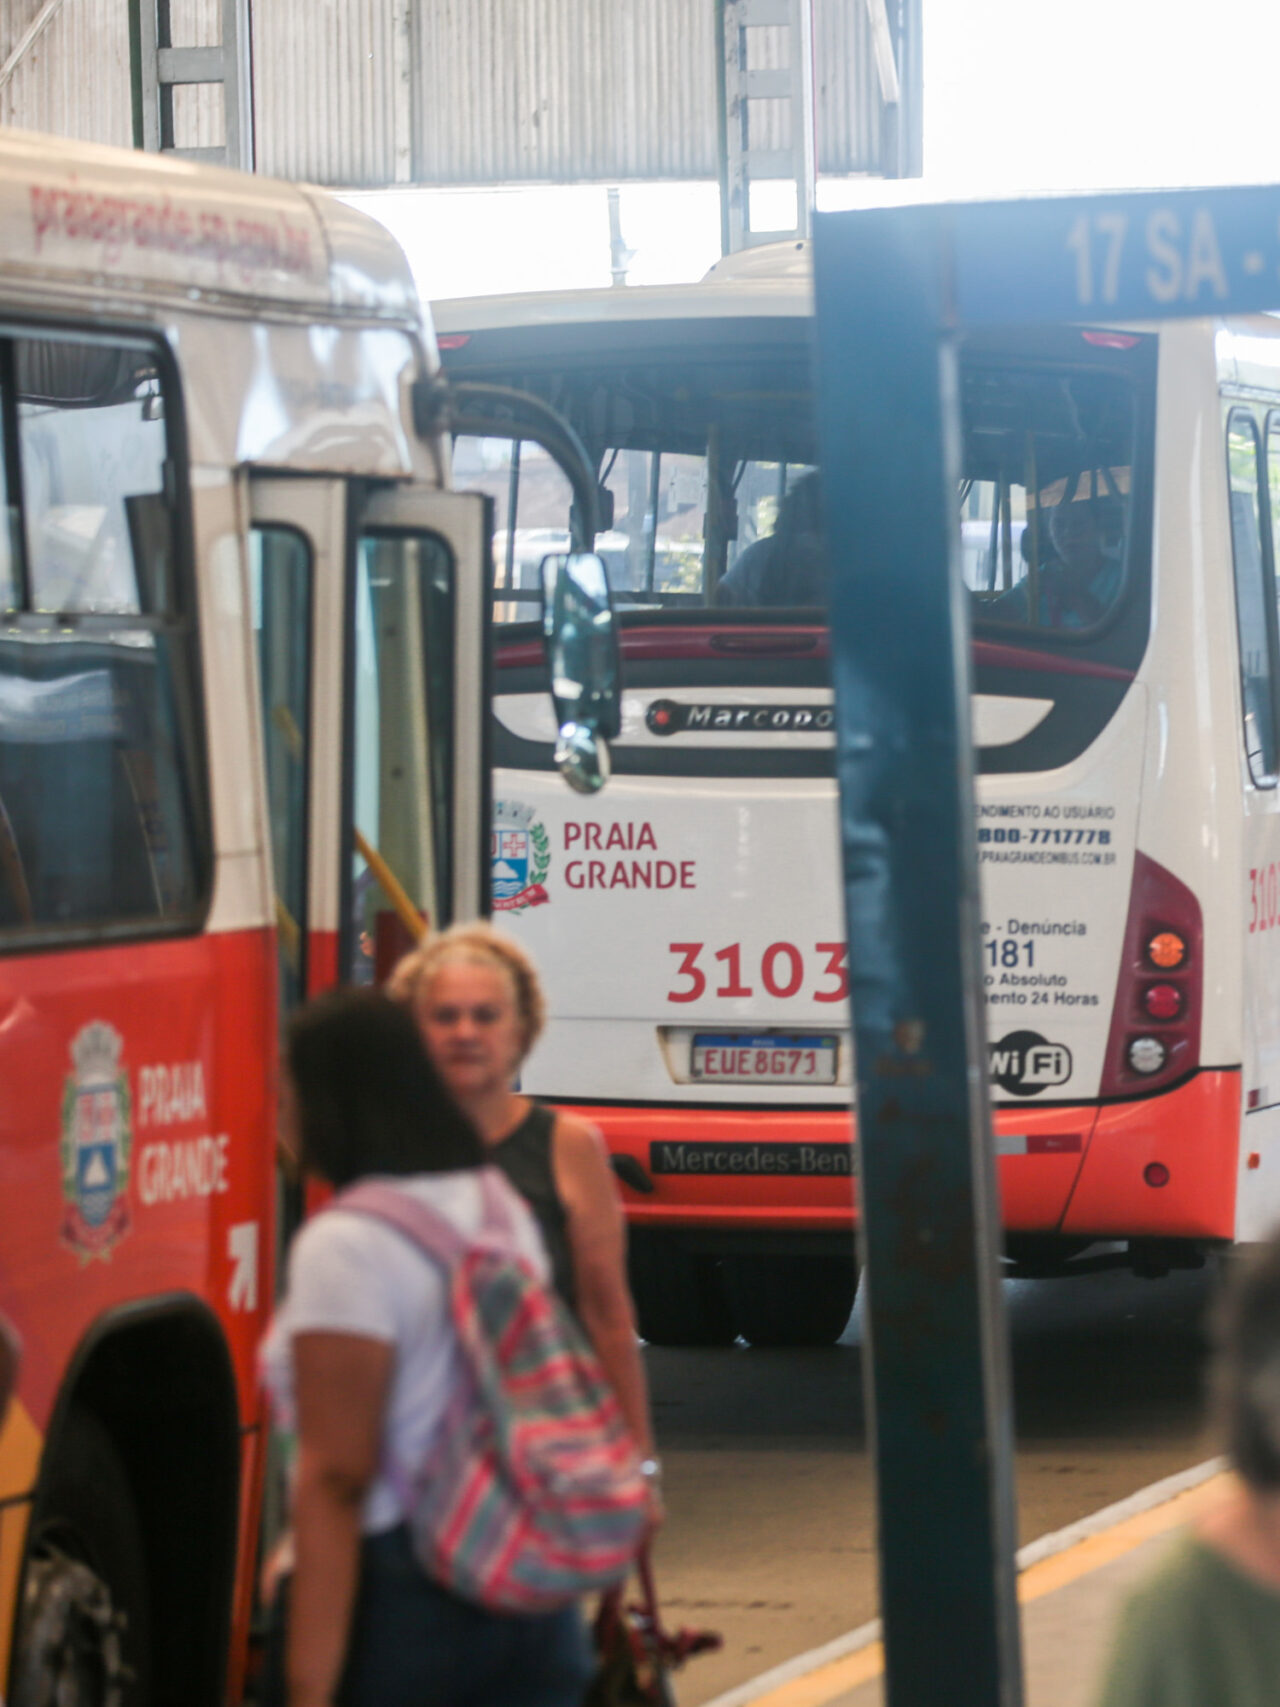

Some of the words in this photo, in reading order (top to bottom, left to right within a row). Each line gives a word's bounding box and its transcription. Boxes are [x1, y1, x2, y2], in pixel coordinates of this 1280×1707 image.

[1066, 211, 1128, 304] 17
[1146, 208, 1229, 304] SA
[1043, 805, 1060, 819] AO
[1063, 803, 1116, 819] USUÁRIO
[563, 822, 658, 851] PRAIA
[564, 860, 697, 889] GRANDE
[1007, 917, 1087, 936] Denúncia
[984, 939, 1034, 968] 181
[667, 941, 850, 1003] 3103
[1000, 973, 1067, 987] Absoluto
[1031, 992, 1049, 1005] 24
[1054, 992, 1099, 1006] Horas
[704, 1048, 816, 1075] EUE8G71
[138, 1061, 207, 1126] PRAIA
[138, 1133, 230, 1205] GRANDE
